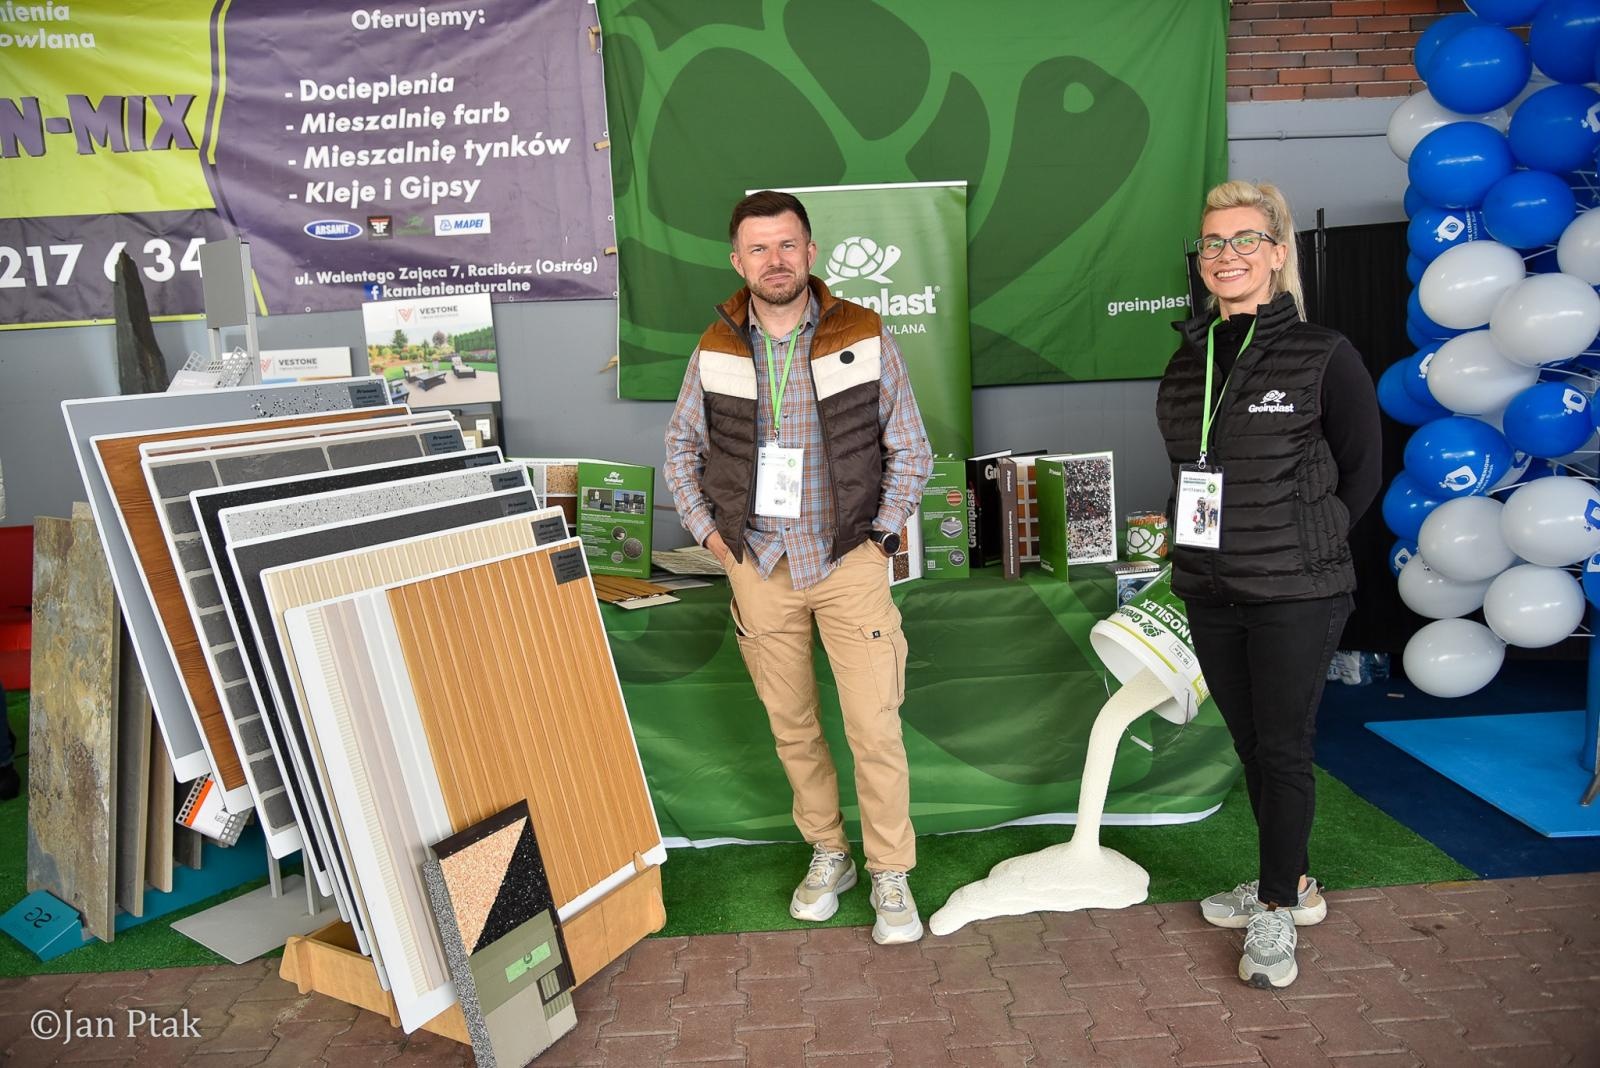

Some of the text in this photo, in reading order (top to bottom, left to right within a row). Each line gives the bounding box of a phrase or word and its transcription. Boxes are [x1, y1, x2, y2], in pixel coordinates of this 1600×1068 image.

[351, 7, 486, 33] Oferujemy:
[0, 27, 96, 49] owlana
[299, 72, 455, 104] Docieplenia
[300, 106, 446, 134] Mieszalnię
[453, 101, 510, 126] farb
[303, 139, 457, 169] Mieszalnię
[463, 132, 572, 167] tynków
[305, 179, 376, 209] Kleje
[384, 178, 392, 201] i
[399, 175, 481, 205] Gipsy
[453, 218, 485, 229] MAPEI
[0, 244, 83, 288] 217
[294, 255, 599, 286] ul. Walentego Zająca 7, Racibórz (Ostróg)
[383, 280, 531, 299] kamienienaturalne
[836, 286, 937, 317] plast
[419, 305, 459, 315] VESTONE
[1107, 294, 1191, 316] greinplast
[278, 357, 319, 367] VESTONE
